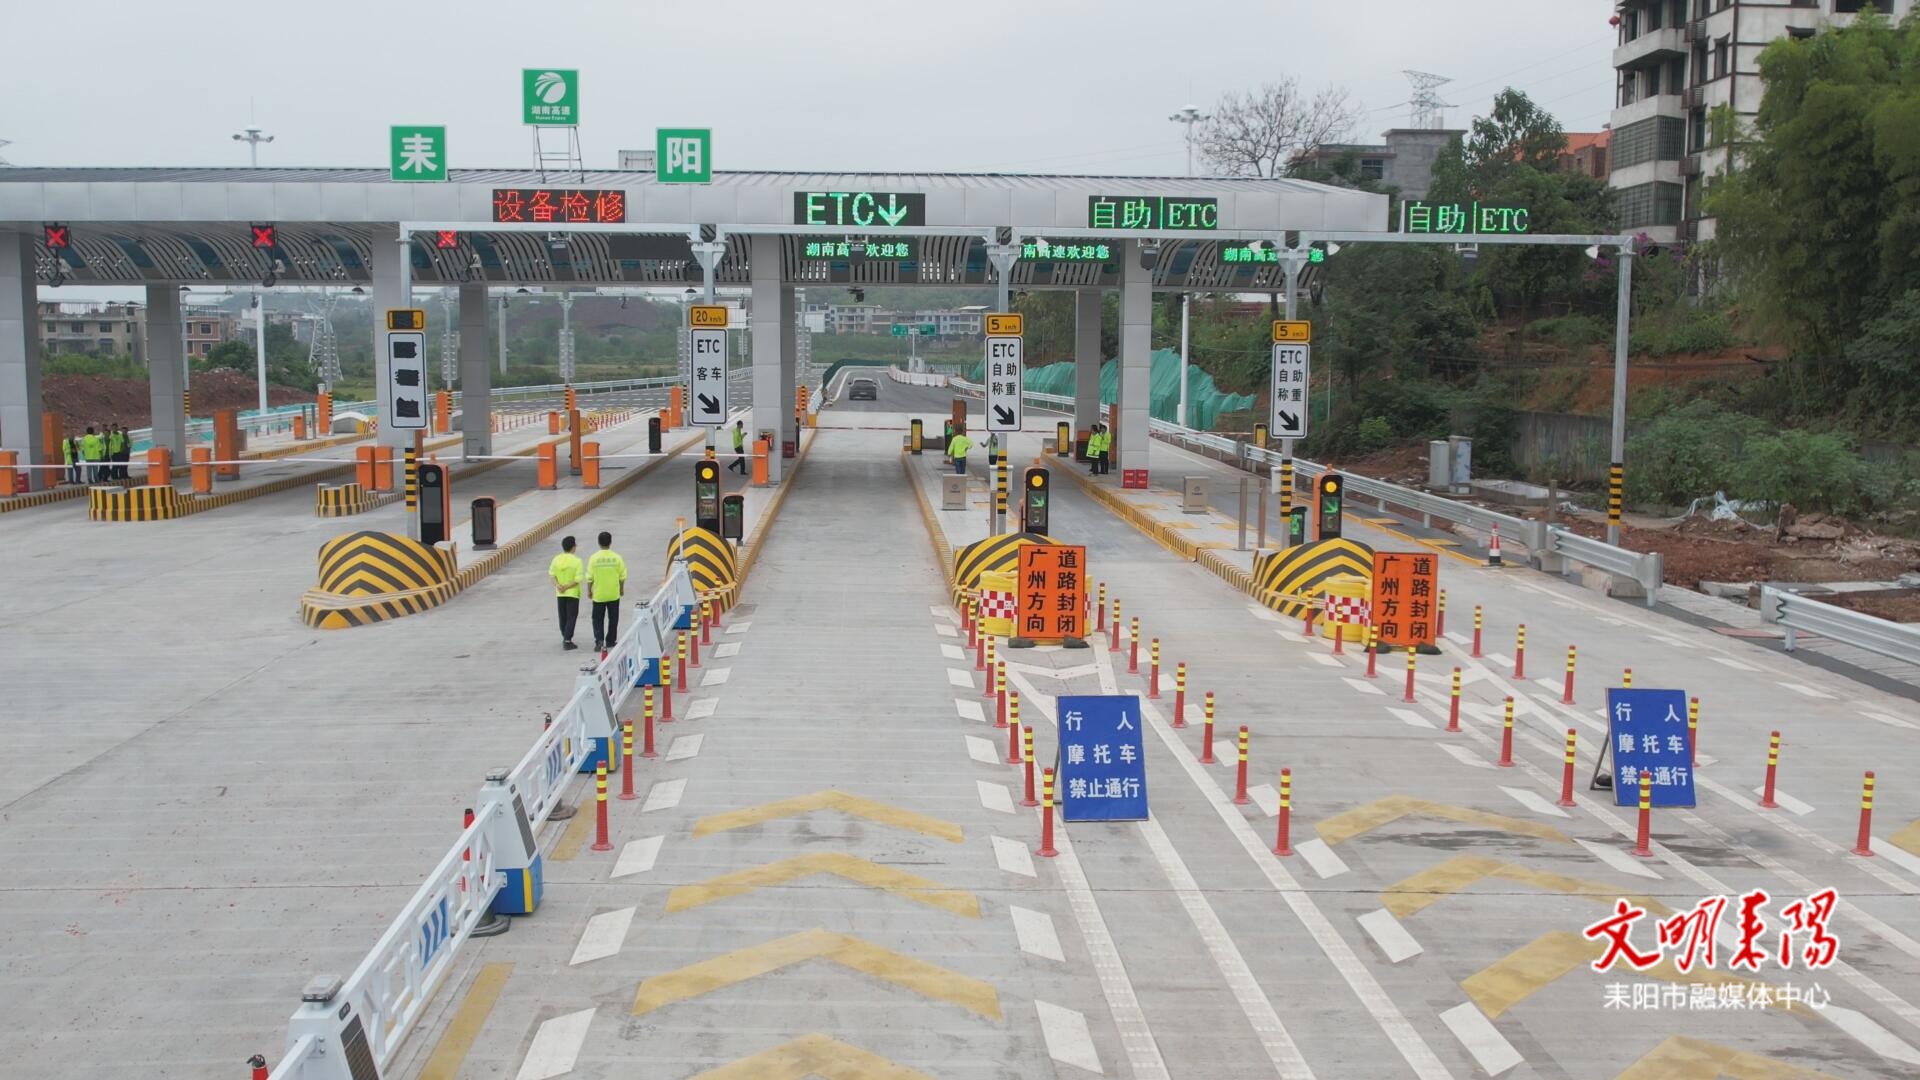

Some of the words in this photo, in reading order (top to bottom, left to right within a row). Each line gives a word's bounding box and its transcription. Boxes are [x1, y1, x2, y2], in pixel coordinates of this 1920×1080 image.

[399, 133, 438, 174] 耒
[666, 136, 702, 175] 阳
[494, 190, 623, 222] 设备检修
[806, 192, 875, 226] ETC
[1094, 197, 1151, 229] 自助
[1167, 203, 1217, 228] ETC
[1409, 201, 1466, 233] 自助
[1480, 207, 1529, 233] ETC
[806, 241, 910, 258] 湖南高欢迎您
[696, 310, 708, 322] 20
[991, 319, 1000, 330] 5
[1279, 325, 1288, 337] 5
[697, 339, 720, 354] ETC
[992, 343, 1015, 358] ETC
[1280, 350, 1302, 364] ETC
[696, 367, 722, 381] 客车
[992, 363, 1017, 377] 自助
[1279, 369, 1303, 383] 自助
[992, 382, 1017, 396] 称重
[1277, 388, 1302, 402] 称重
[1026, 548, 1048, 633] 广州方向
[1056, 549, 1078, 633] 道路封闭
[1380, 556, 1401, 639] 广州方向
[1410, 557, 1432, 640] 道路封闭
[1065, 710, 1134, 732] 行人
[1615, 702, 1681, 722] 行人
[1067, 743, 1137, 765] 摩托车
[1618, 733, 1685, 755] 摩托车
[1069, 777, 1140, 799] 禁止通行
